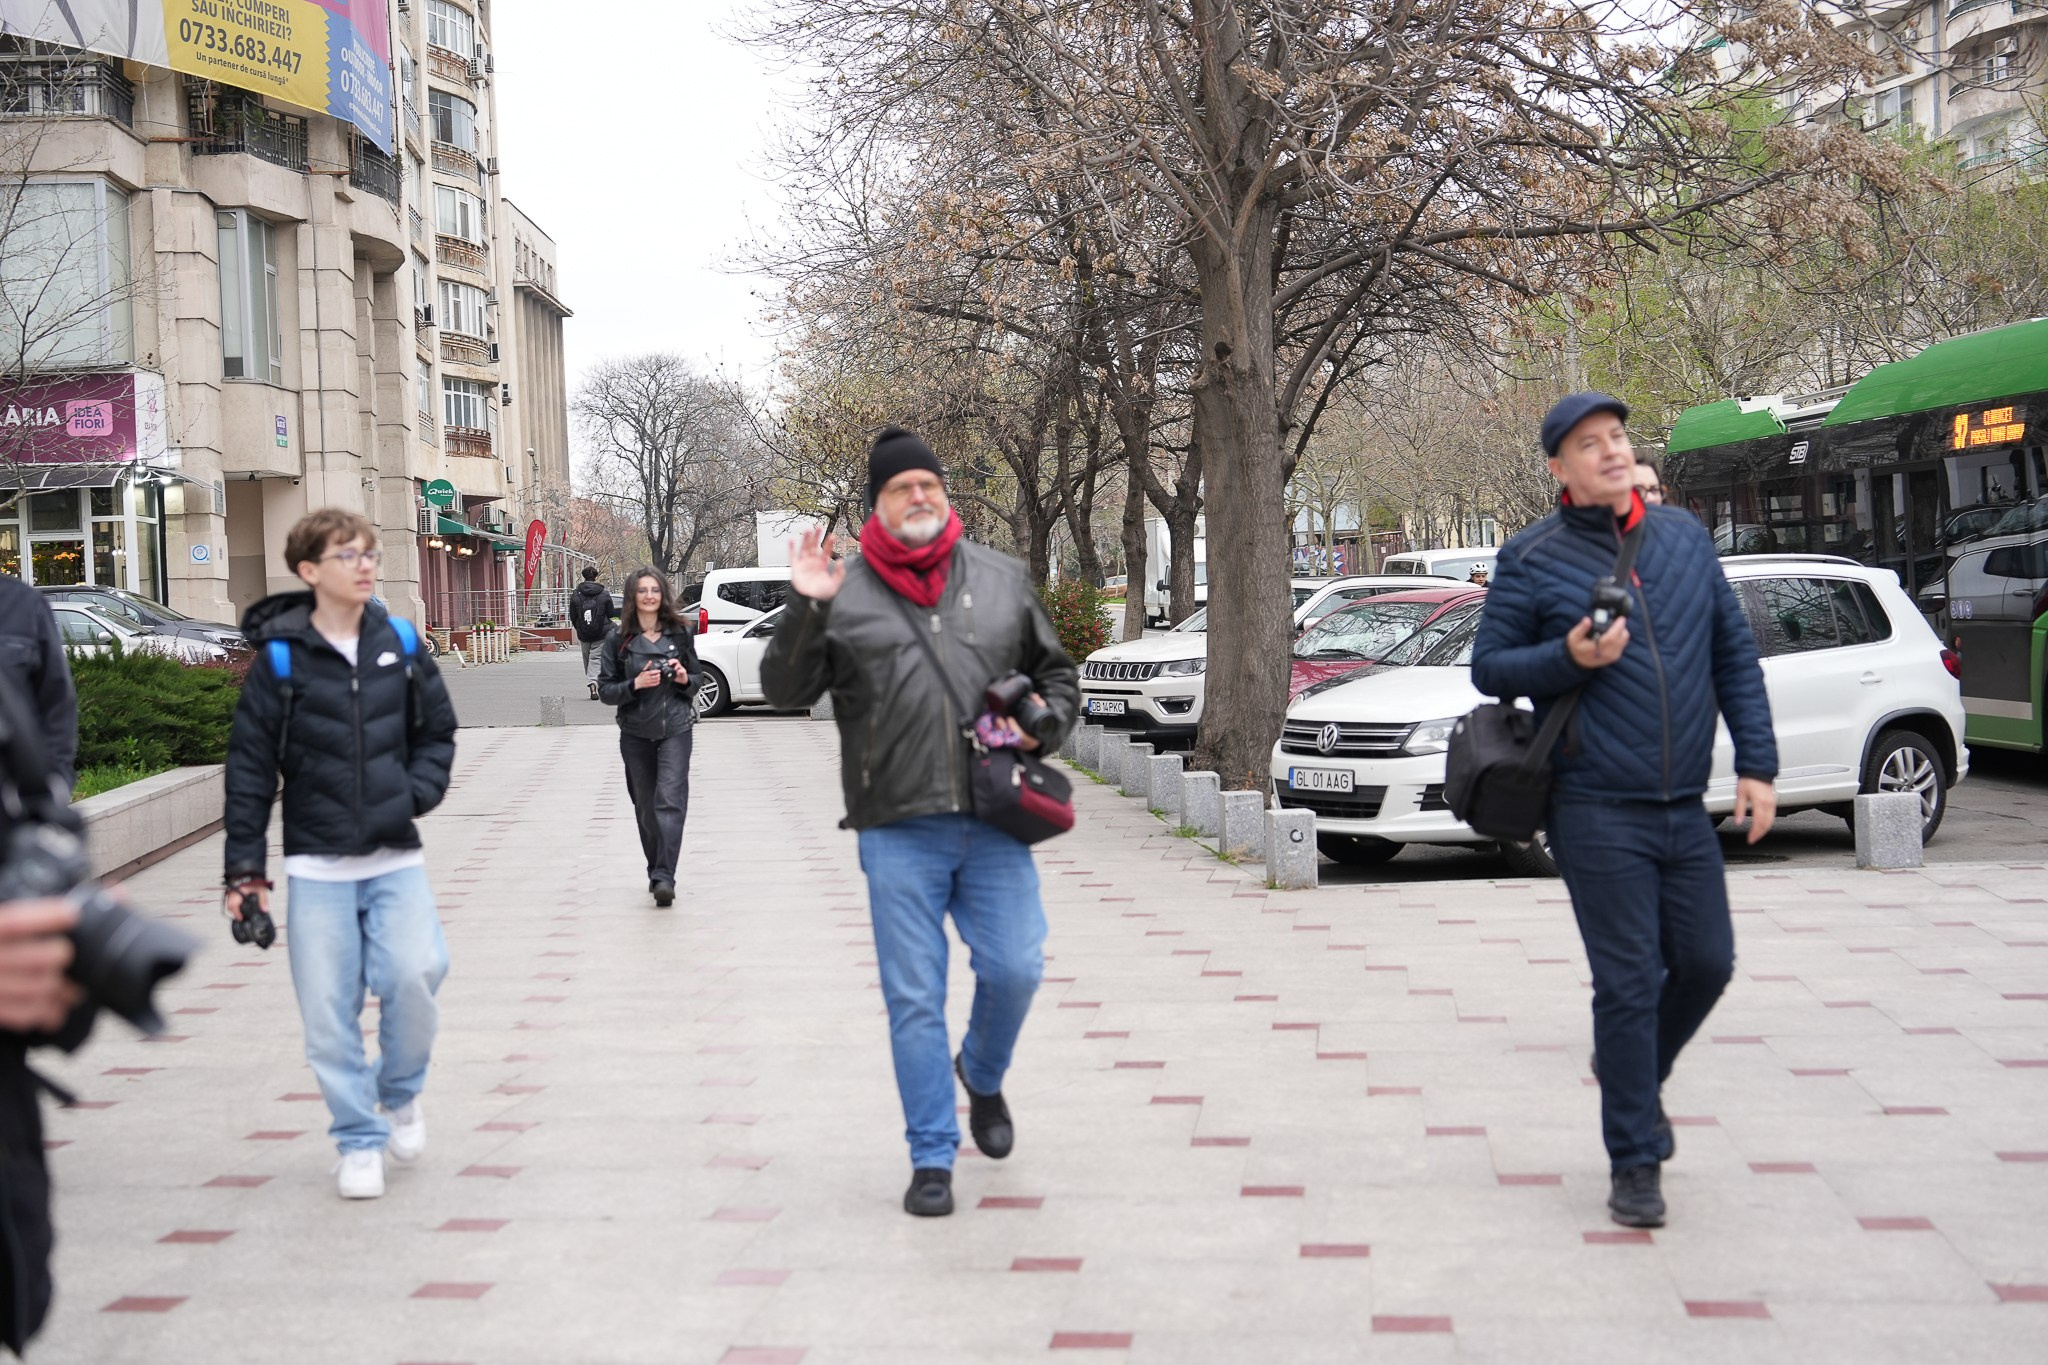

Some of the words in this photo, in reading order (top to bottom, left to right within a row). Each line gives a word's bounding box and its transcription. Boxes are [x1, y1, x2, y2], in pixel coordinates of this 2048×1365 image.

[191, 0, 218, 18] SAU
[221, 5, 292, 41] INCHIRIEZI?
[237, 0, 290, 24] CUMPERI
[180, 18, 302, 75] 0733.683.447
[196, 51, 207, 62] Un
[208, 56, 239, 71] partener
[240, 63, 249, 73] de
[0, 404, 61, 426] ĂRIA
[74, 407, 103, 418] IDEA
[74, 418, 105, 429] FIORI
[1092, 701, 1101, 711] DB
[1296, 771, 1309, 787] GL
[1313, 772, 1323, 788] 01
[1326, 772, 1349, 789] AAG
